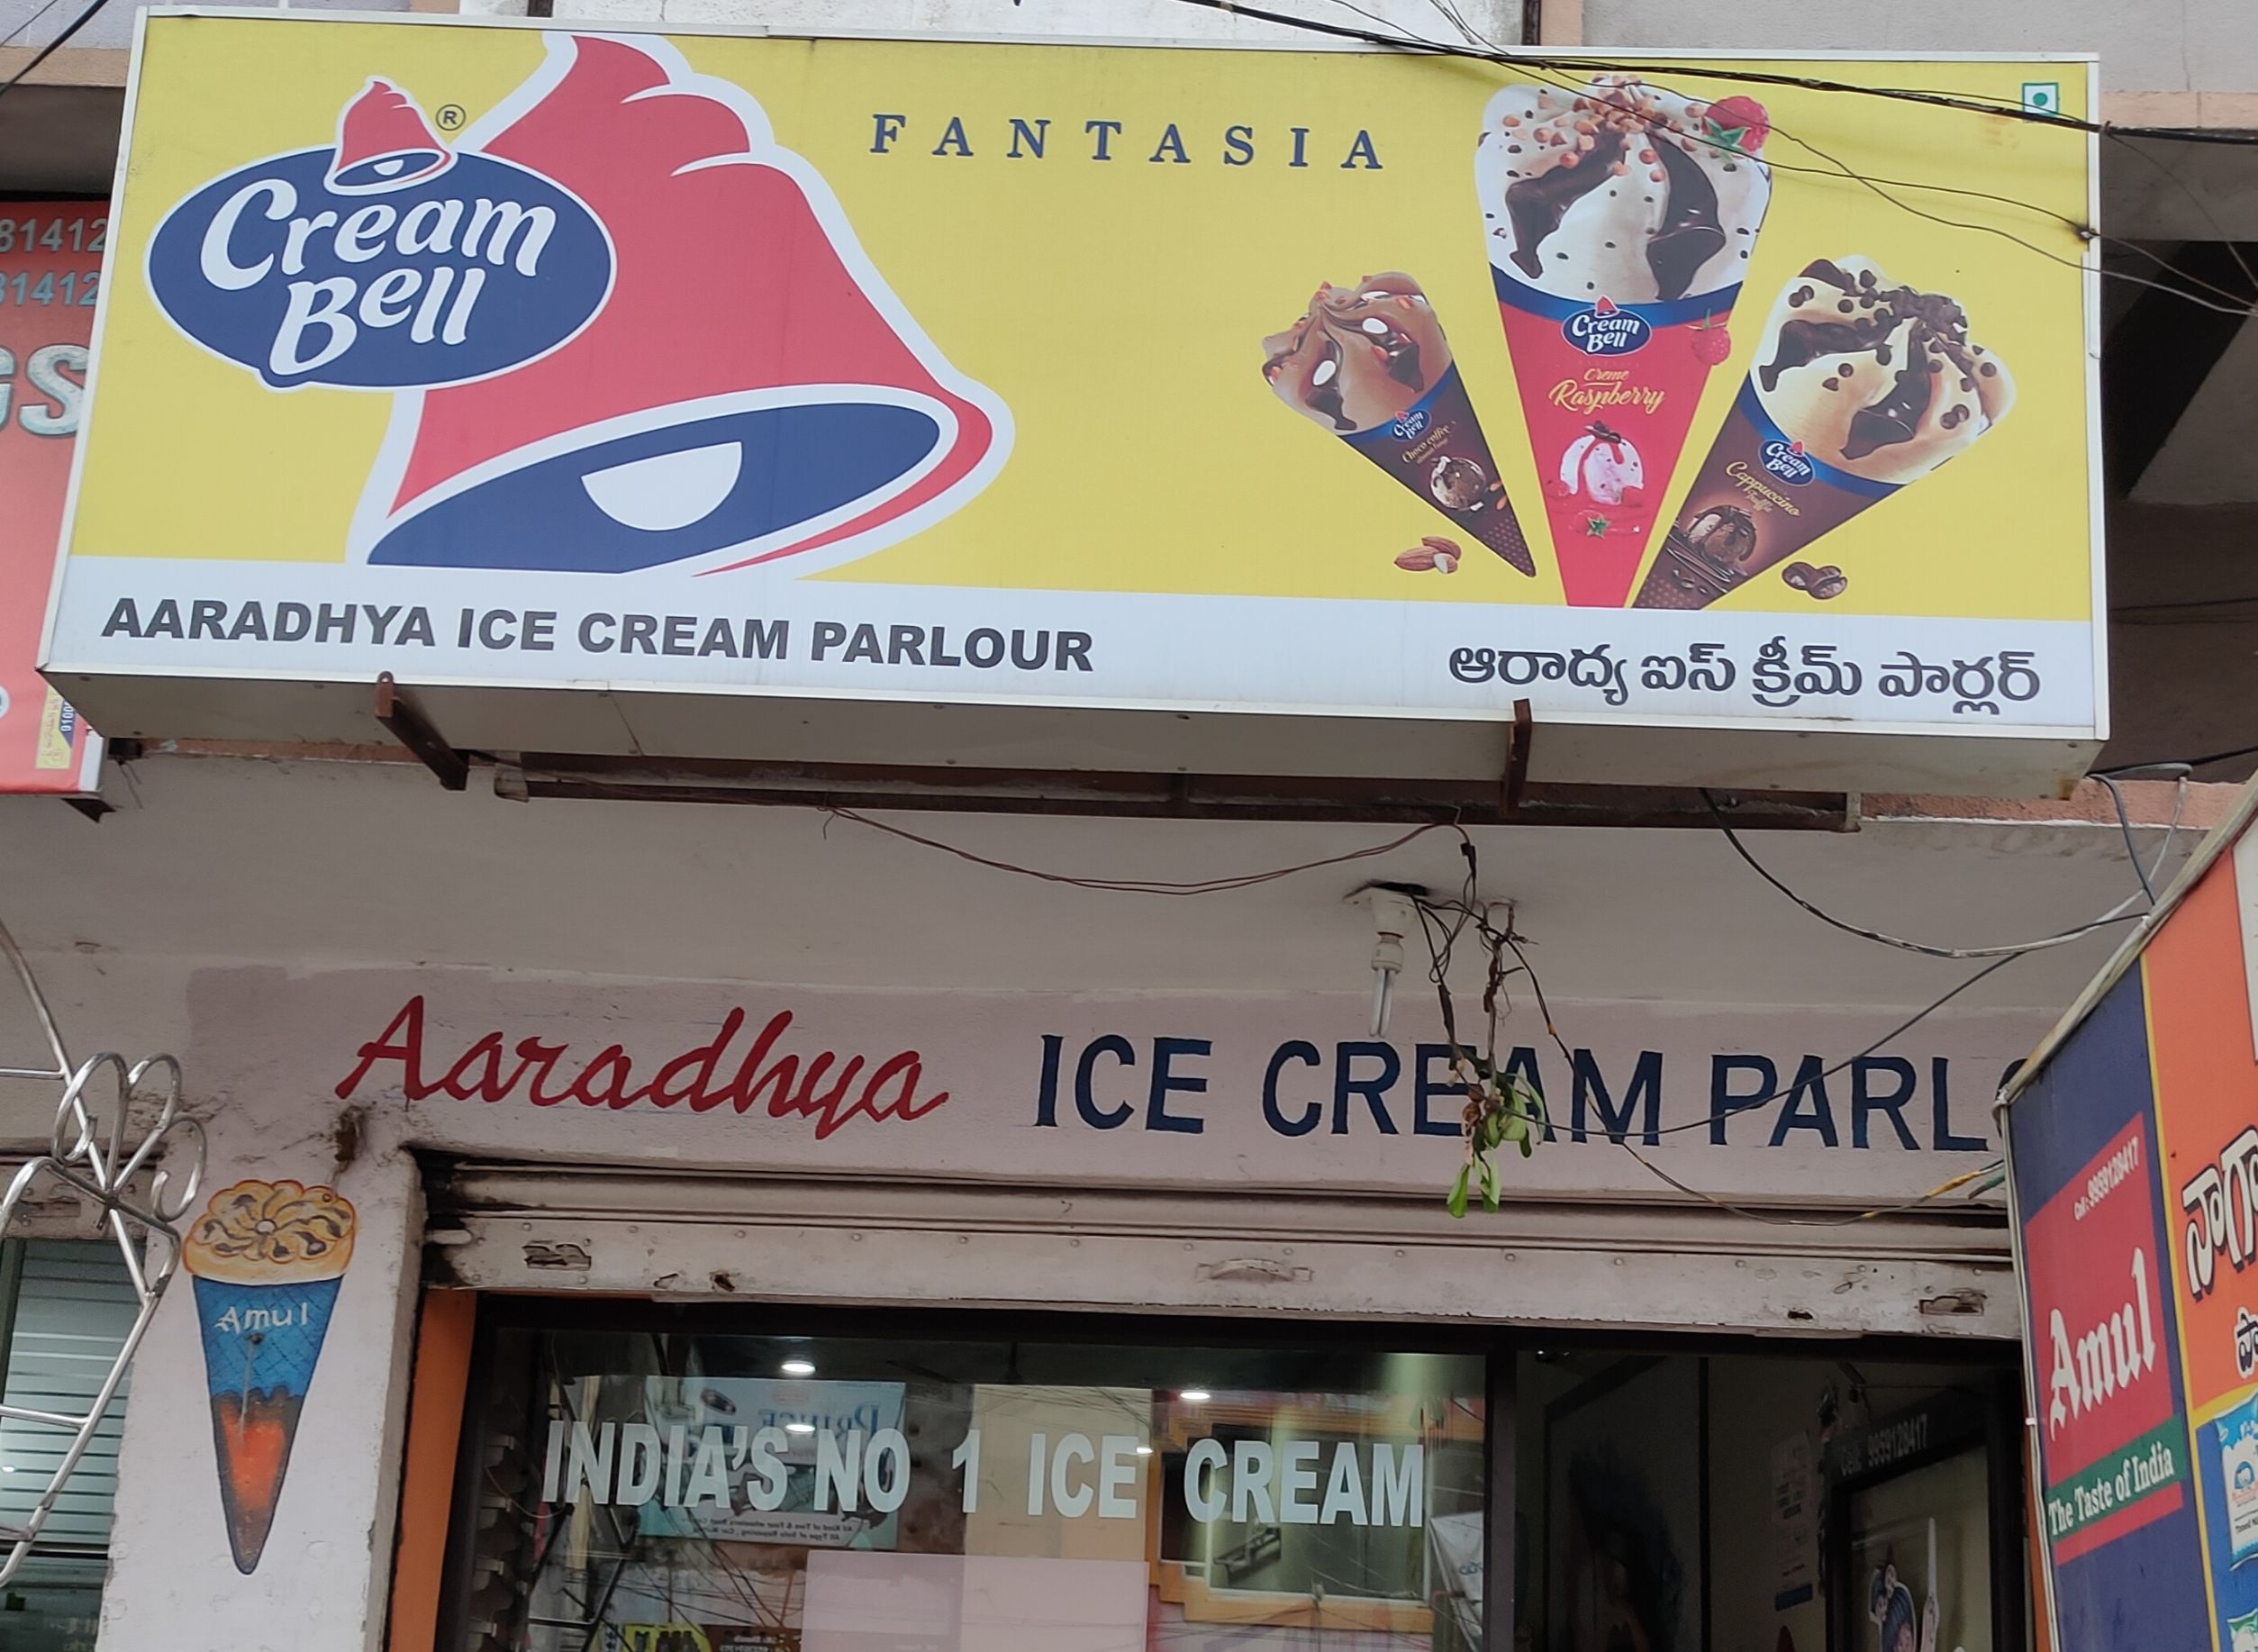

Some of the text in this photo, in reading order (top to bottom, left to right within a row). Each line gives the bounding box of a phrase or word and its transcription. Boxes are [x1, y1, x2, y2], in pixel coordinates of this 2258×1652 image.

[869, 113, 1384, 170] FANTASIA
[200, 179, 557, 291] Cream
[268, 267, 486, 376] Bell
[1572, 314, 1640, 337] Cream
[1586, 331, 1628, 353] Bell
[1548, 379, 1664, 414] Raspberry
[1765, 442, 1811, 477] Cream
[1765, 458, 1798, 478] Bell
[101, 597, 1095, 673] AARADHYA ICE CREAM PARLOUR
[1640, 642, 1736, 692] ఐస్
[1752, 635, 1862, 708] క్రీమ్
[1879, 650, 2040, 715] పార్లర్
[334, 994, 950, 1141] Aaradhya
[1034, 1034, 1213, 1135] ICE
[214, 1301, 309, 1335] Amul
[2050, 1247, 2156, 1442] Amul
[541, 1419, 1424, 1529] INDIA'S NO 1 ICE CREAM
[2047, 1441, 2175, 1536] The Taste of India
